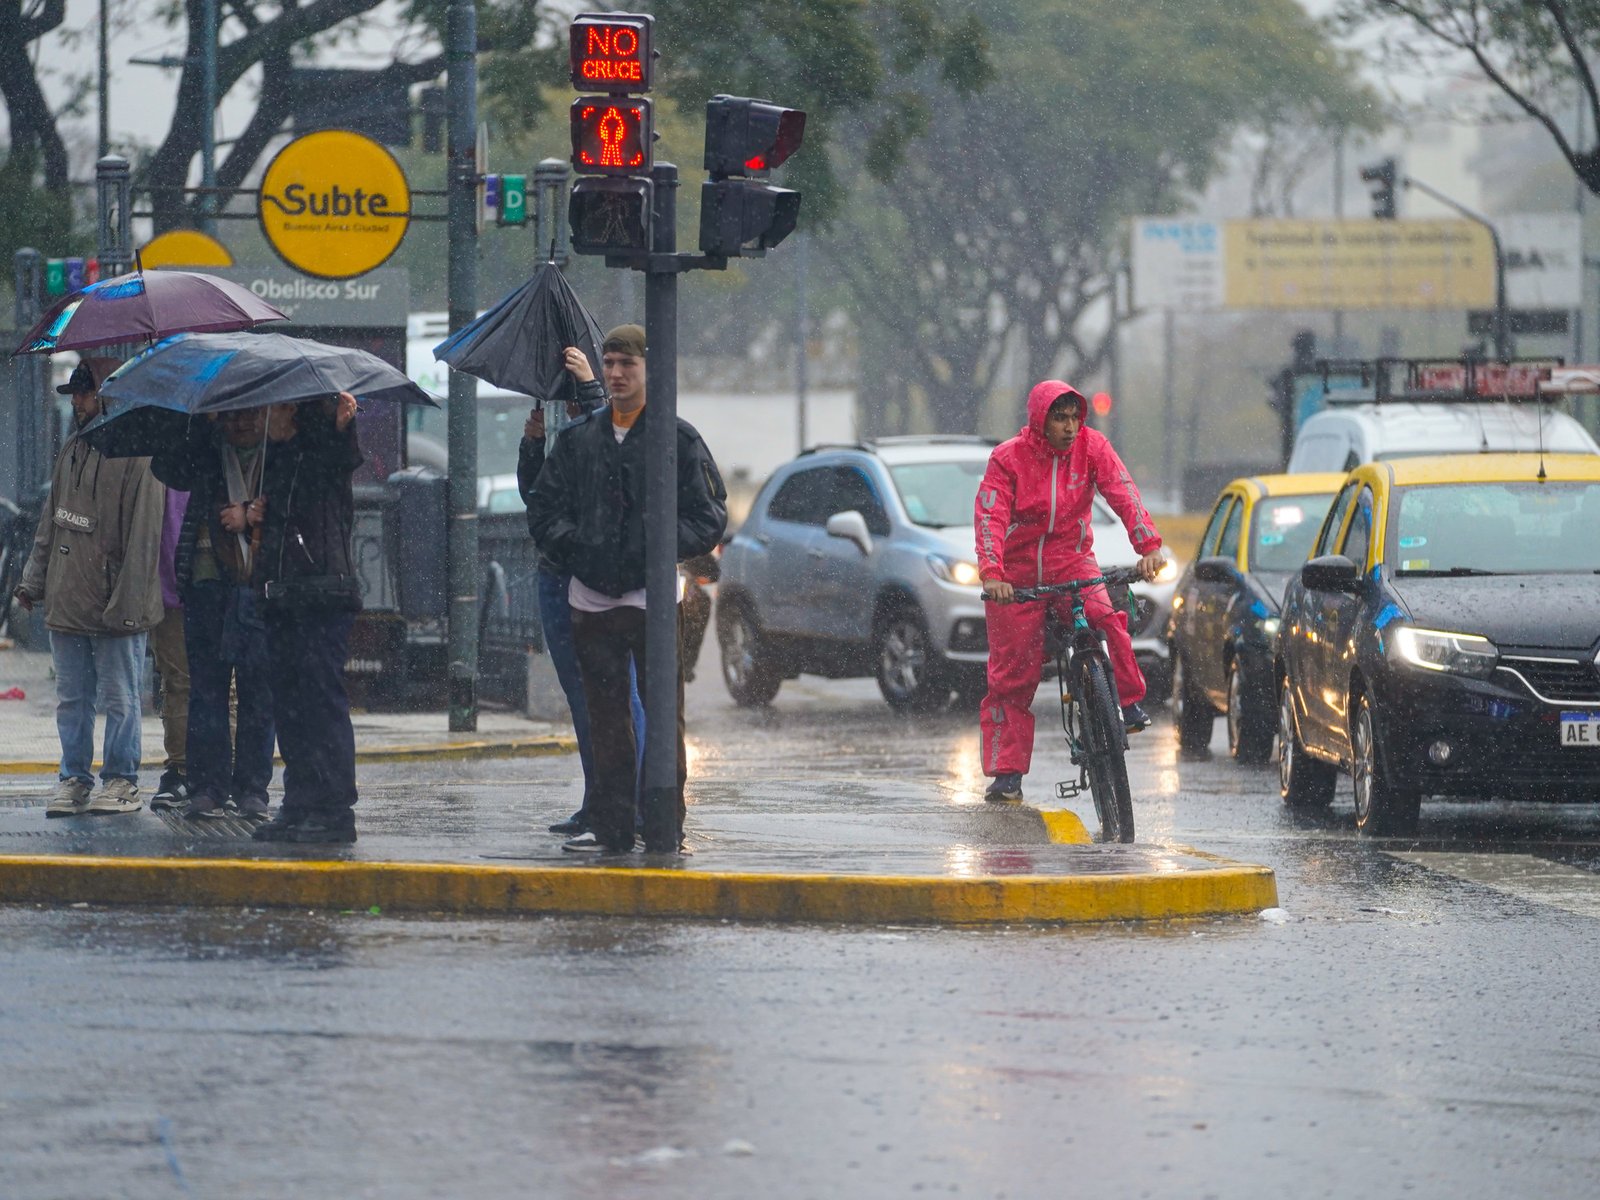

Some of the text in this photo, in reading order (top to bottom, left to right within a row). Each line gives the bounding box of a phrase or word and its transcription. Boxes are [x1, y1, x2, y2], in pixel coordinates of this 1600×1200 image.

[587, 26, 638, 56] NO
[582, 60, 641, 79] CRUCE
[284, 183, 390, 216] Subte
[505, 190, 523, 208] D
[251, 278, 381, 299] Obelisco Sur
[1566, 723, 1590, 742] AE
